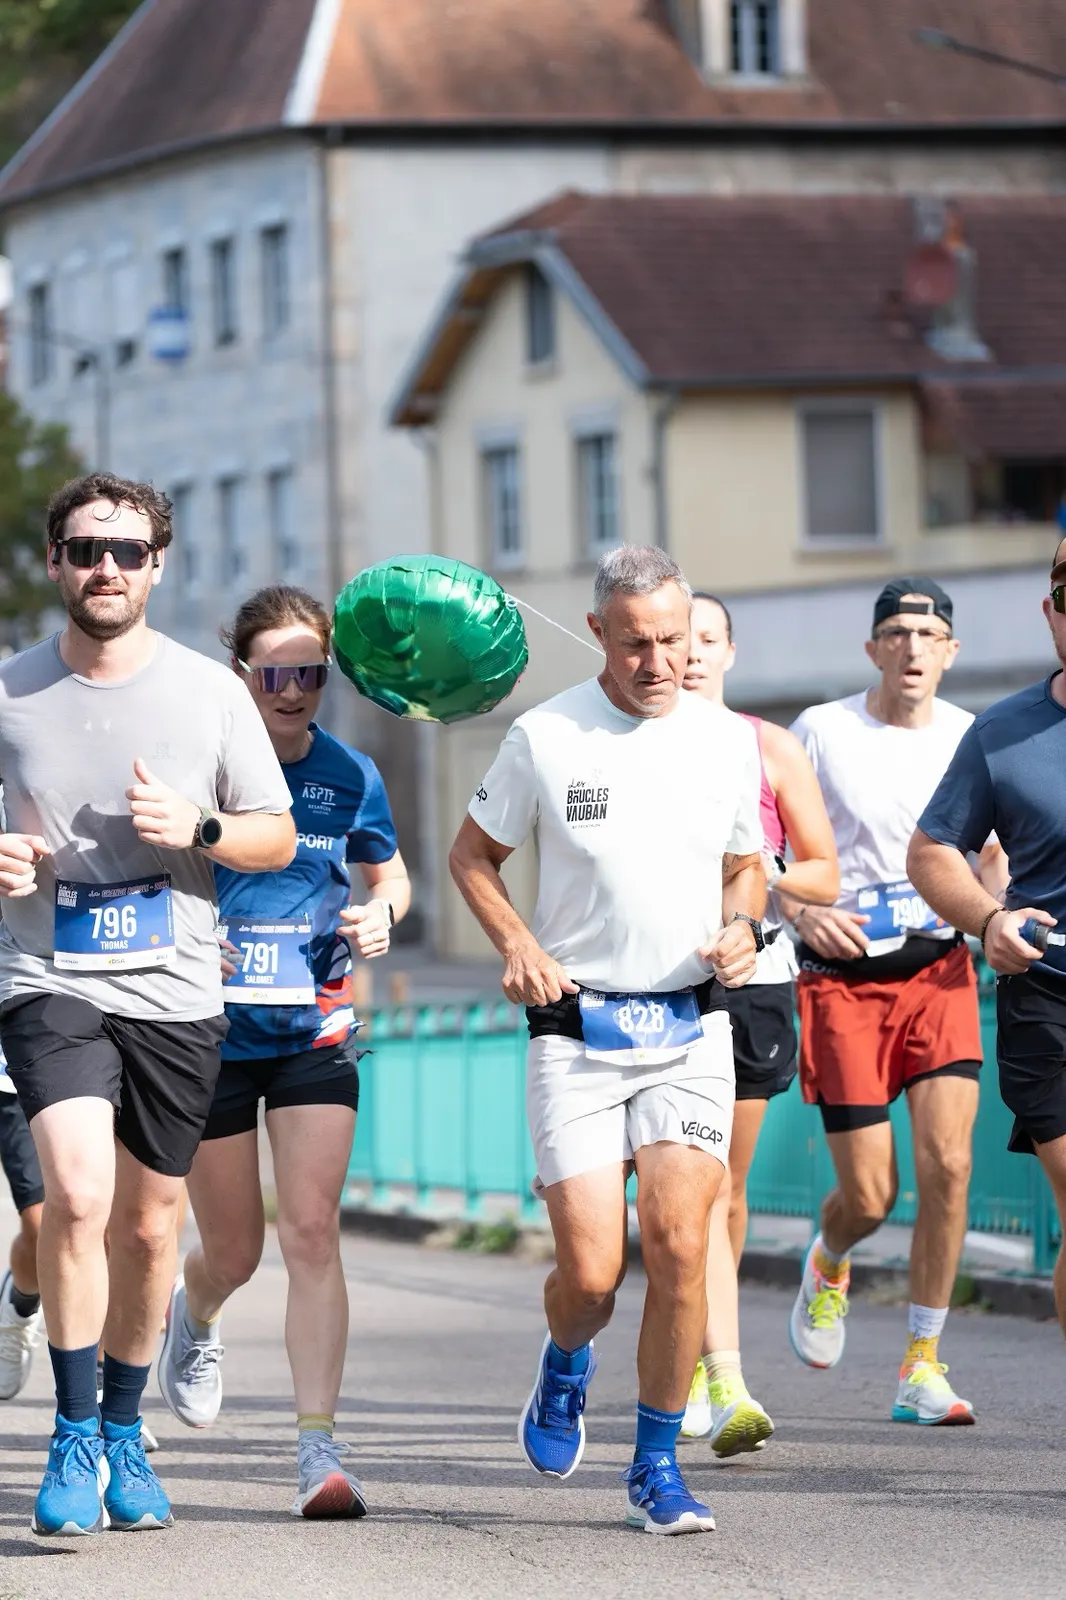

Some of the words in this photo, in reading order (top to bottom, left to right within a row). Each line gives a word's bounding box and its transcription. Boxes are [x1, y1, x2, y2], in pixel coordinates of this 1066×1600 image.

[568, 778, 586, 789] Les
[302, 786, 335, 802] ASPTT
[567, 787, 609, 804] BOUCLES
[566, 803, 607, 822] VAUBAN
[89, 905, 137, 939] 796
[100, 940, 129, 949] THOMAS
[240, 942, 279, 974] 791
[244, 975, 275, 985] SALOMEE
[618, 1004, 665, 1034] 828
[681, 1120, 723, 1145] VELCAP
